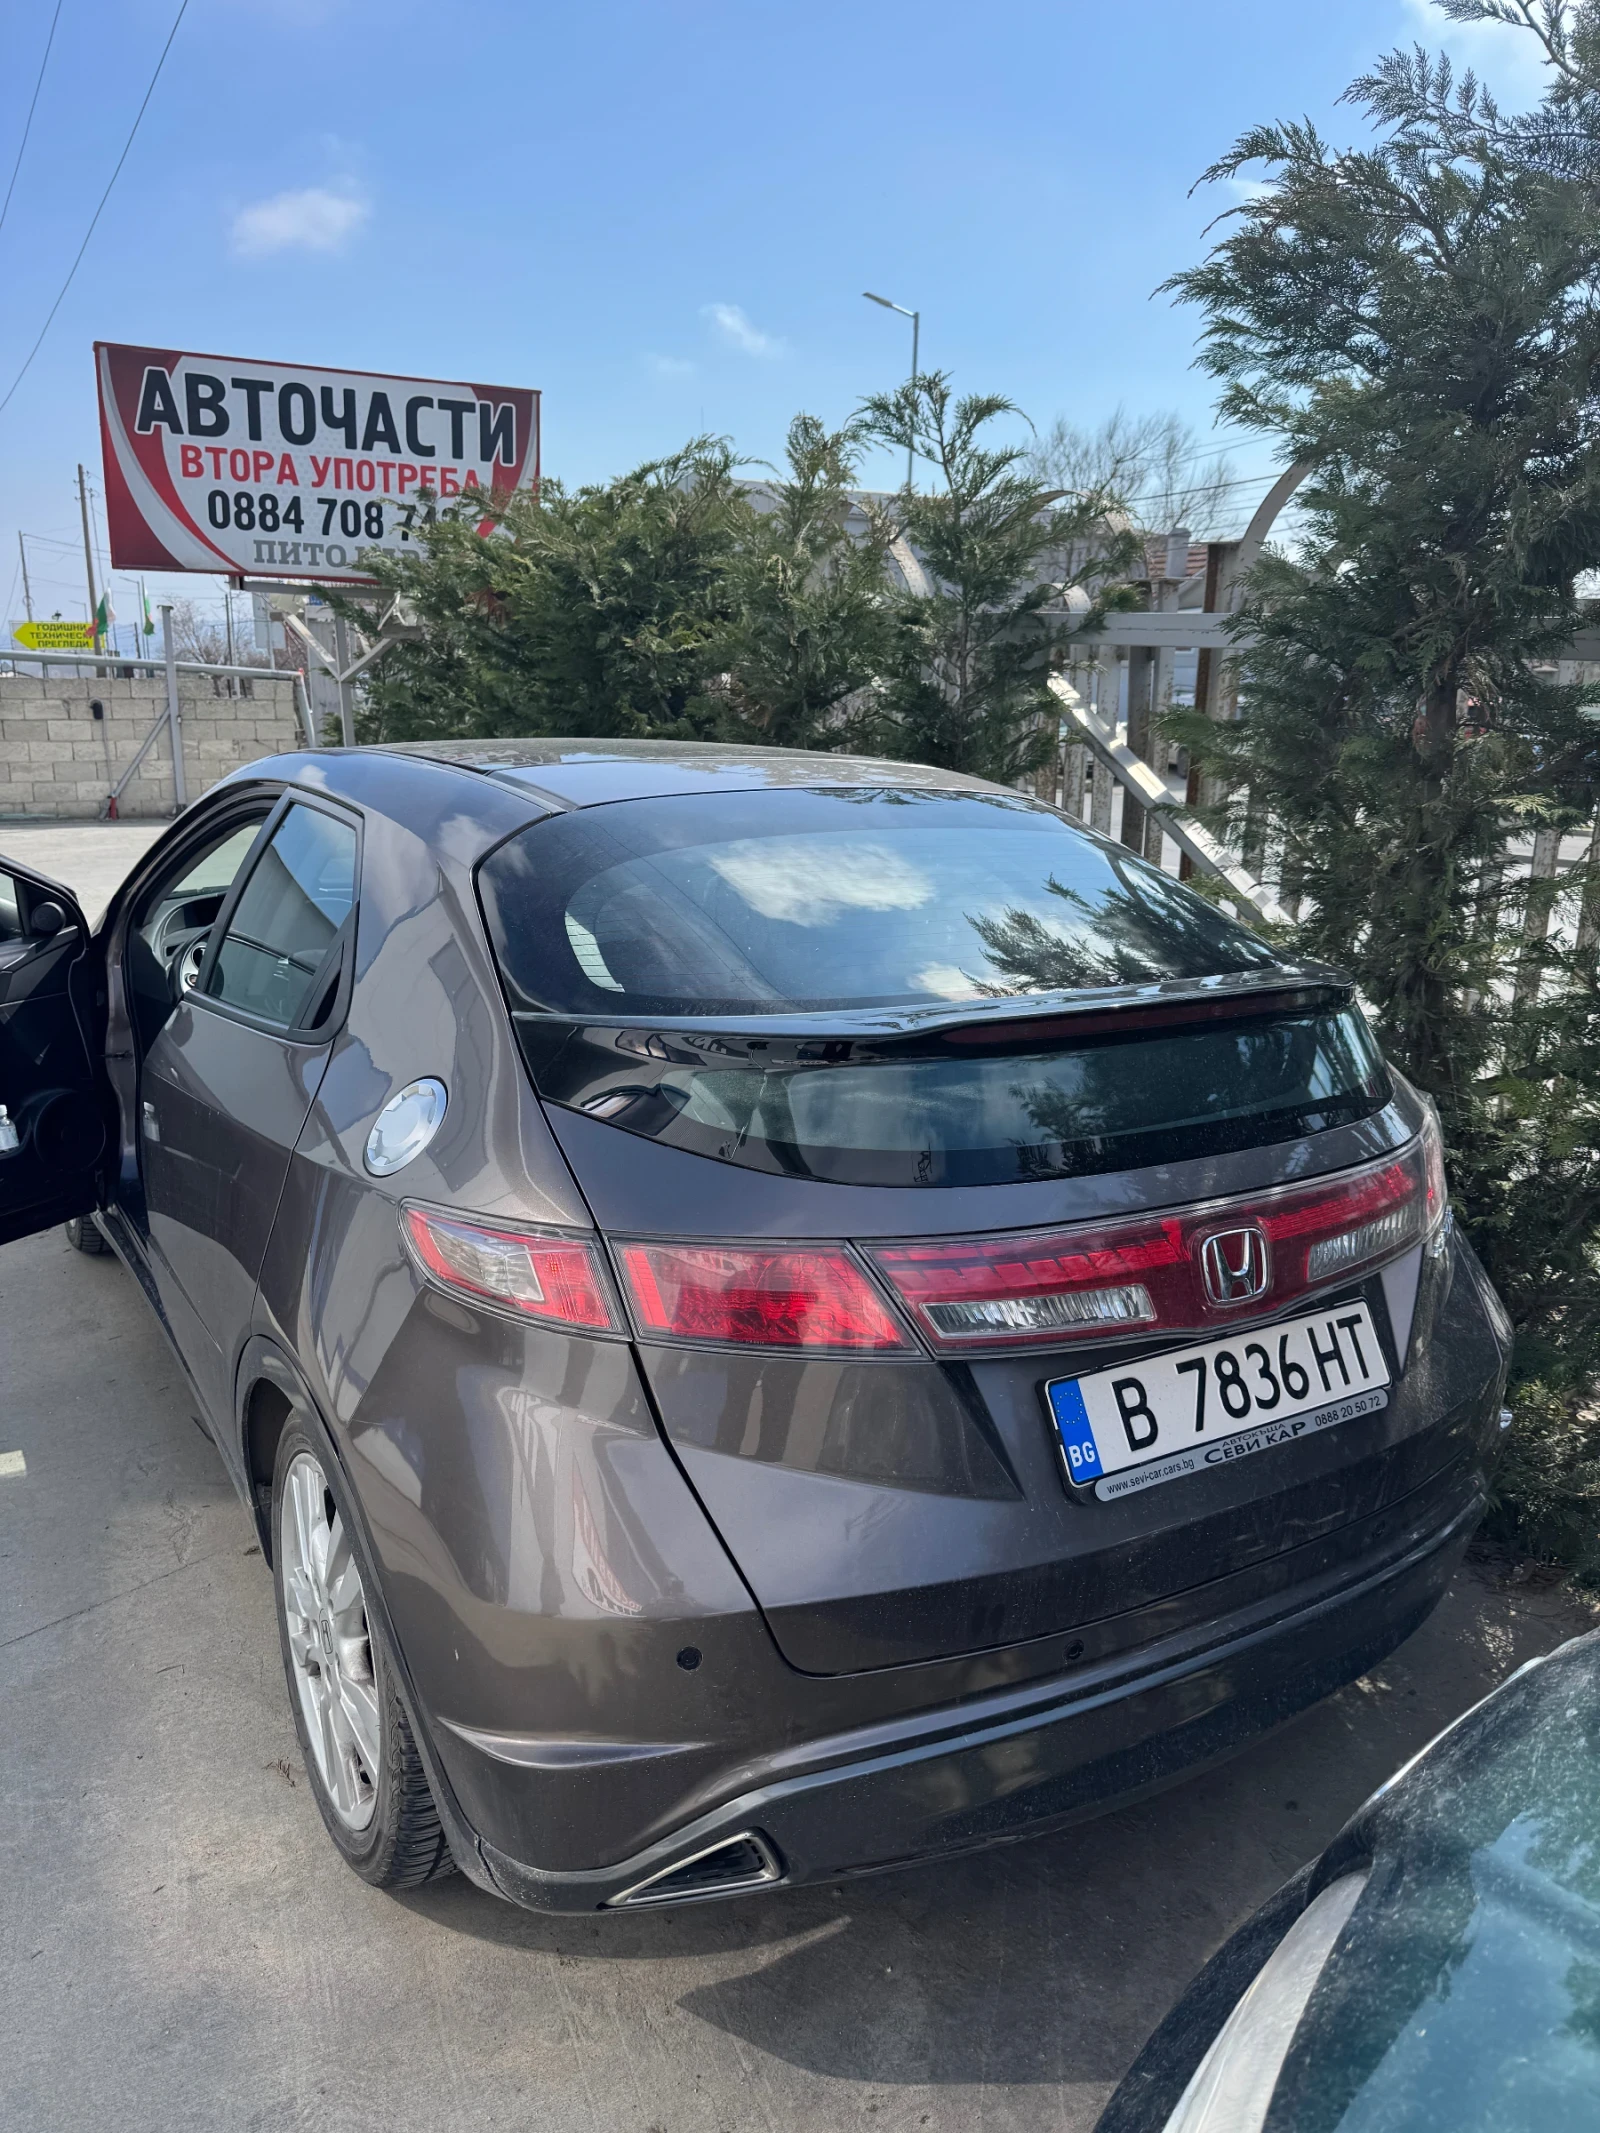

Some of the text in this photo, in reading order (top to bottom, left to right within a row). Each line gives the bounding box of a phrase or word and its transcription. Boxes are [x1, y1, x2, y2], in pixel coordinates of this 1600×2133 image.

[137, 367, 515, 465] АВТОЧАСТИ
[181, 444, 299, 487] ВТОРА
[207, 489, 304, 534] 0884
[317, 496, 383, 539] 708
[253, 539, 348, 568] ПИТО
[36, 623, 87, 632] ГОДИШНИ
[37, 640, 90, 648] ПРЕГЛЕДИ
[1111, 1377, 1159, 1452] B
[1315, 1395, 1381, 1427] 0888 20 50 72
[1204, 1421, 1307, 1463] СЕВИ КАР
[1222, 1423, 1286, 1448] АВТОКЪЩА
[1069, 1441, 1096, 1468] BG
[1106, 1458, 1195, 1494] www.sevi-car.cars.bg
